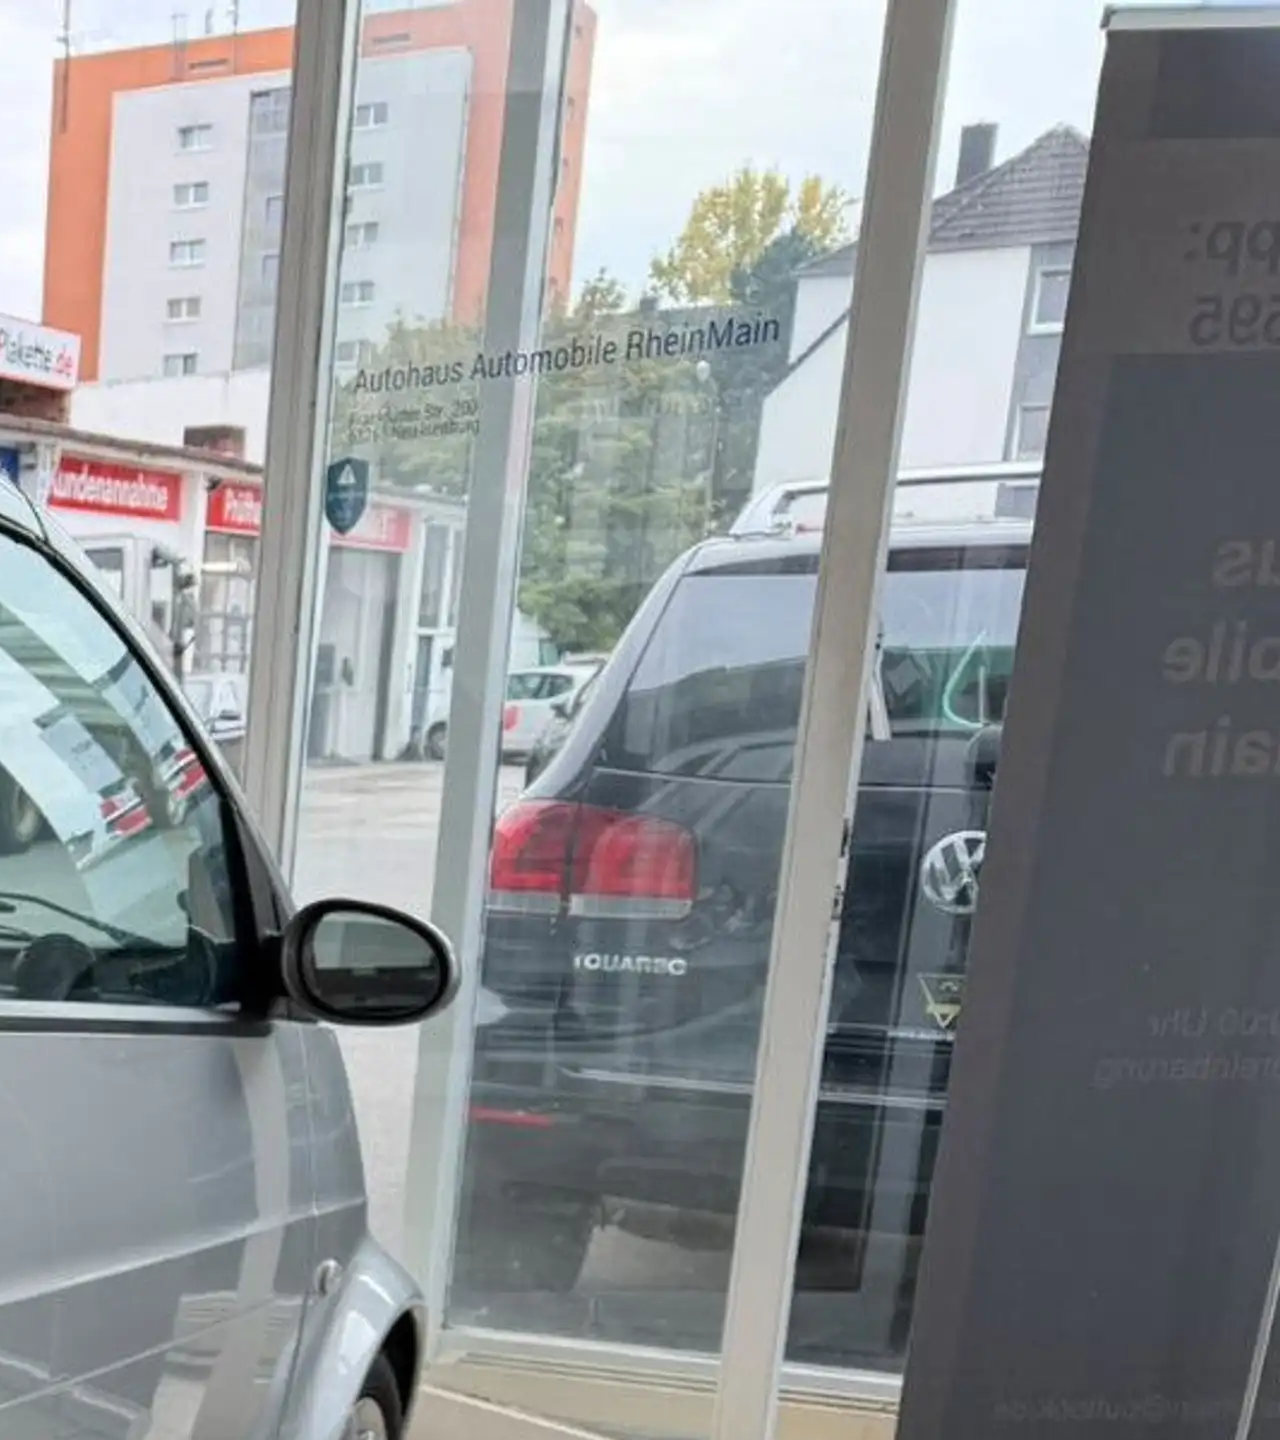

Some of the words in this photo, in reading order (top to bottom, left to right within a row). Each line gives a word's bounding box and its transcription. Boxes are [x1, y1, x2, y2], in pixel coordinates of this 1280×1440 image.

[353, 359, 464, 396] Autohaus
[470, 335, 618, 382] Automobile
[625, 318, 780, 362] RheinMain
